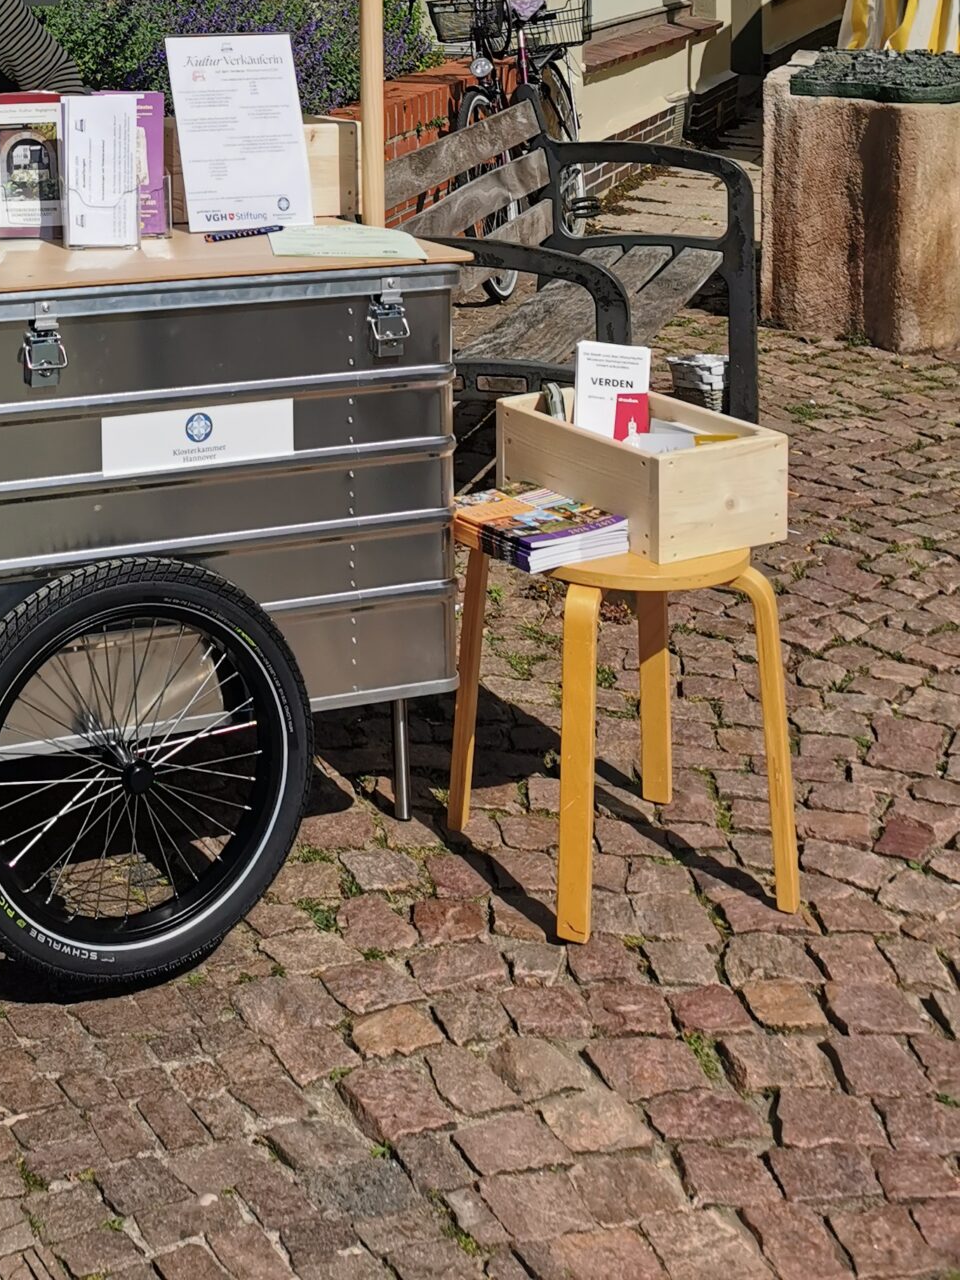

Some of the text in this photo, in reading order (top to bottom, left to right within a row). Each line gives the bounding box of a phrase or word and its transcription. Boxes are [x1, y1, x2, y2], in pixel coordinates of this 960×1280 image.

[205, 212, 228, 222] VGH
[236, 211, 268, 222] Stiftung
[591, 377, 634, 389] VERDEN
[172, 444, 226, 457] Klosterkammer
[182, 453, 217, 463] Hannover
[29, 927, 98, 960] SCHWALBE
